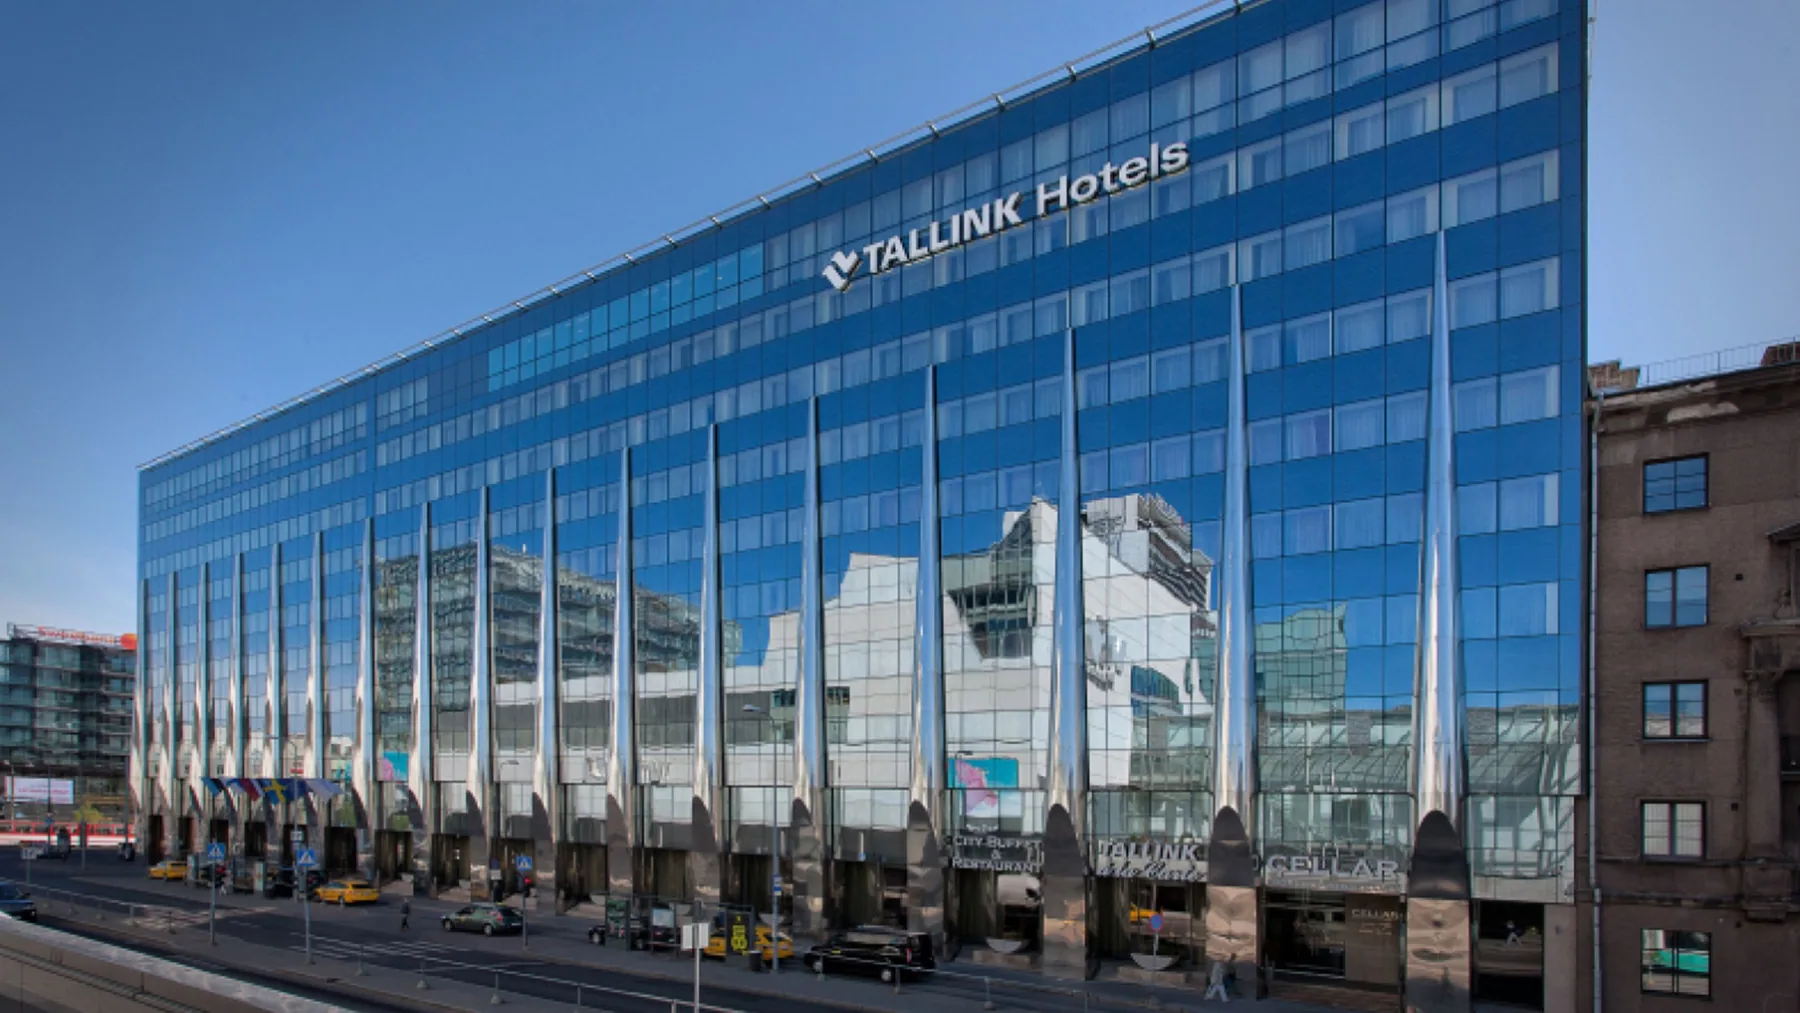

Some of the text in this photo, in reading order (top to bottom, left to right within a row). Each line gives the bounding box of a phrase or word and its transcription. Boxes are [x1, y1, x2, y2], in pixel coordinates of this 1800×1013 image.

[863, 141, 1189, 274] TALLINK Hotels
[1098, 839, 1199, 862] TALLINK
[1266, 854, 1399, 882] CELLAR
